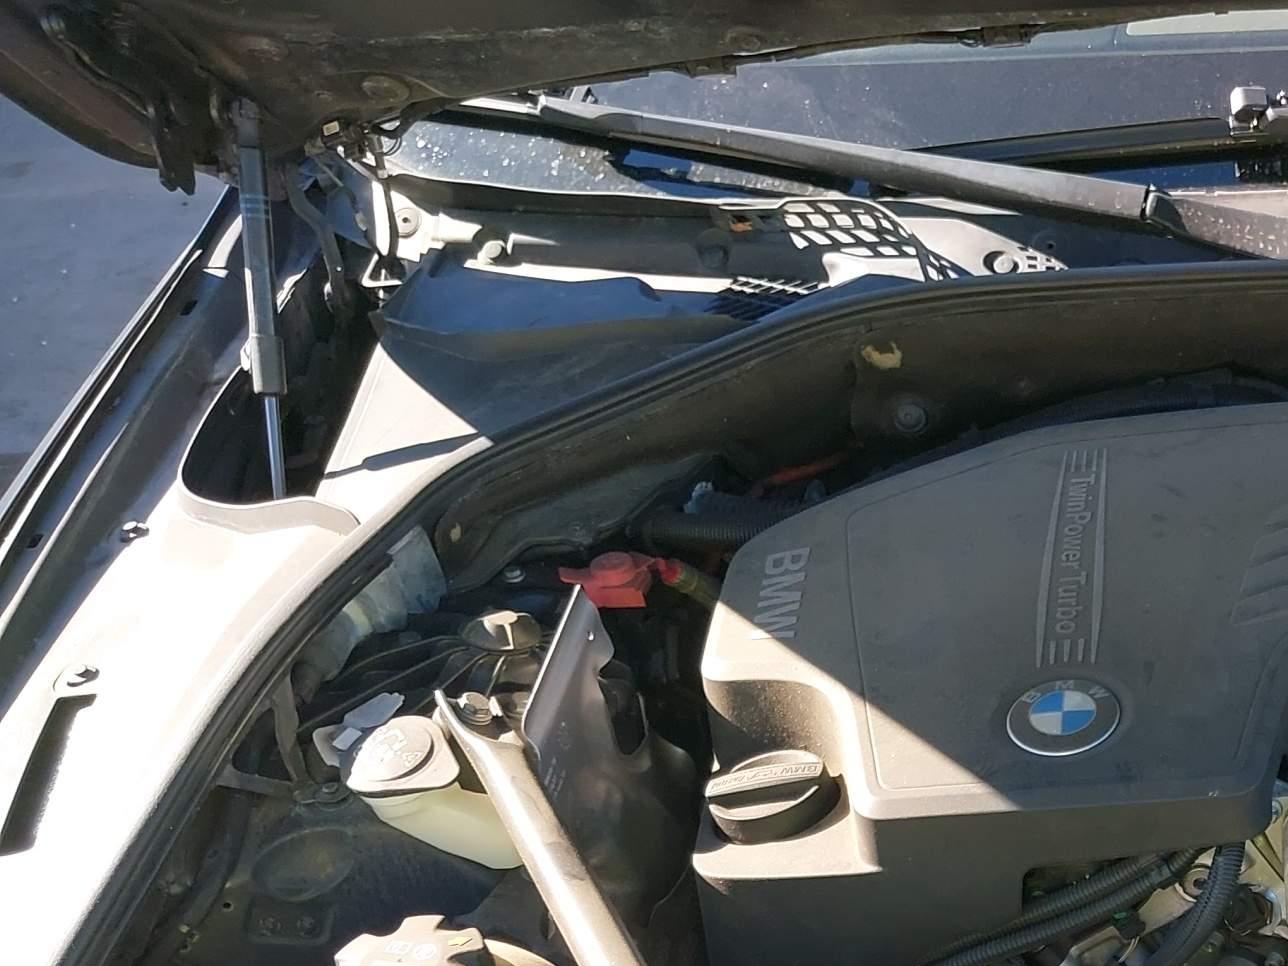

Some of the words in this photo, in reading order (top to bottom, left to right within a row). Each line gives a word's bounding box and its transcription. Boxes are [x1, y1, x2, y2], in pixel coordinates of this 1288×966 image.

[1061, 472, 1096, 570] TwinPower
[746, 546, 811, 640] BMW
[1055, 571, 1089, 635] Turbo
[1022, 680, 1110, 703] BMW
